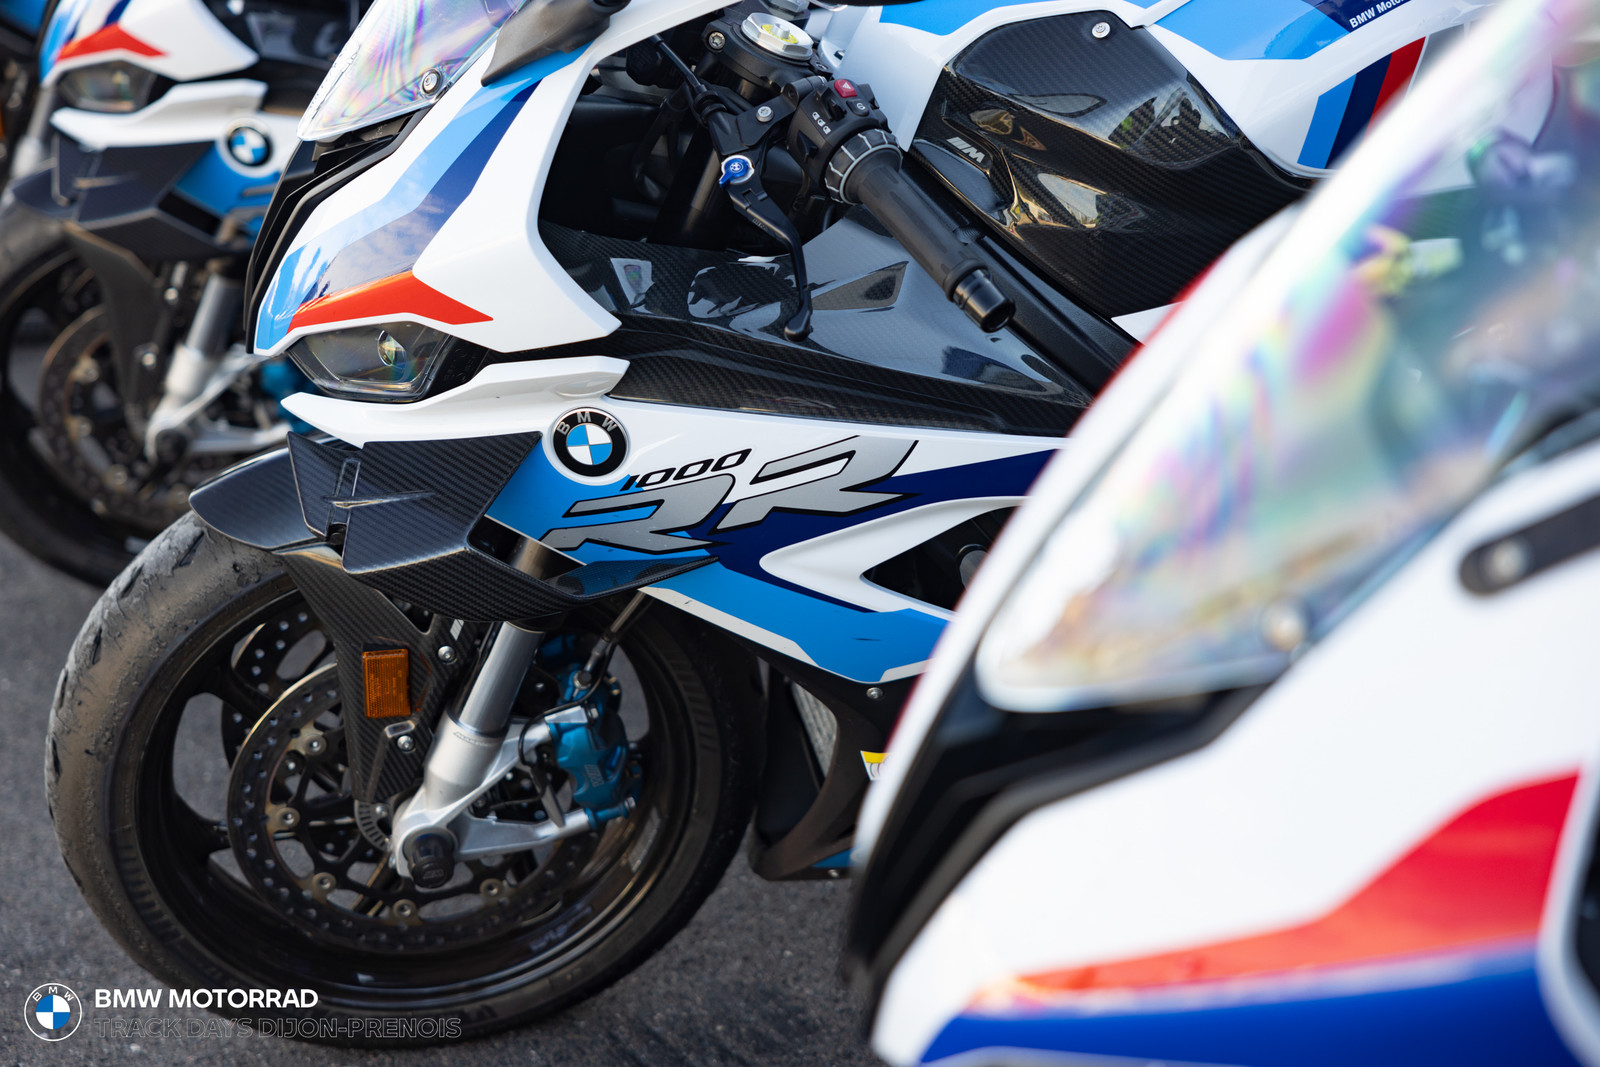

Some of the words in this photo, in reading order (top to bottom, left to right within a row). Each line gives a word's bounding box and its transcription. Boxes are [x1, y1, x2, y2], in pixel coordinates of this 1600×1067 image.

[1349, 7, 1376, 28] BMW
[1376, 0, 1404, 13] Moto
[557, 411, 618, 436] BMW
[619, 448, 752, 492] 1000
